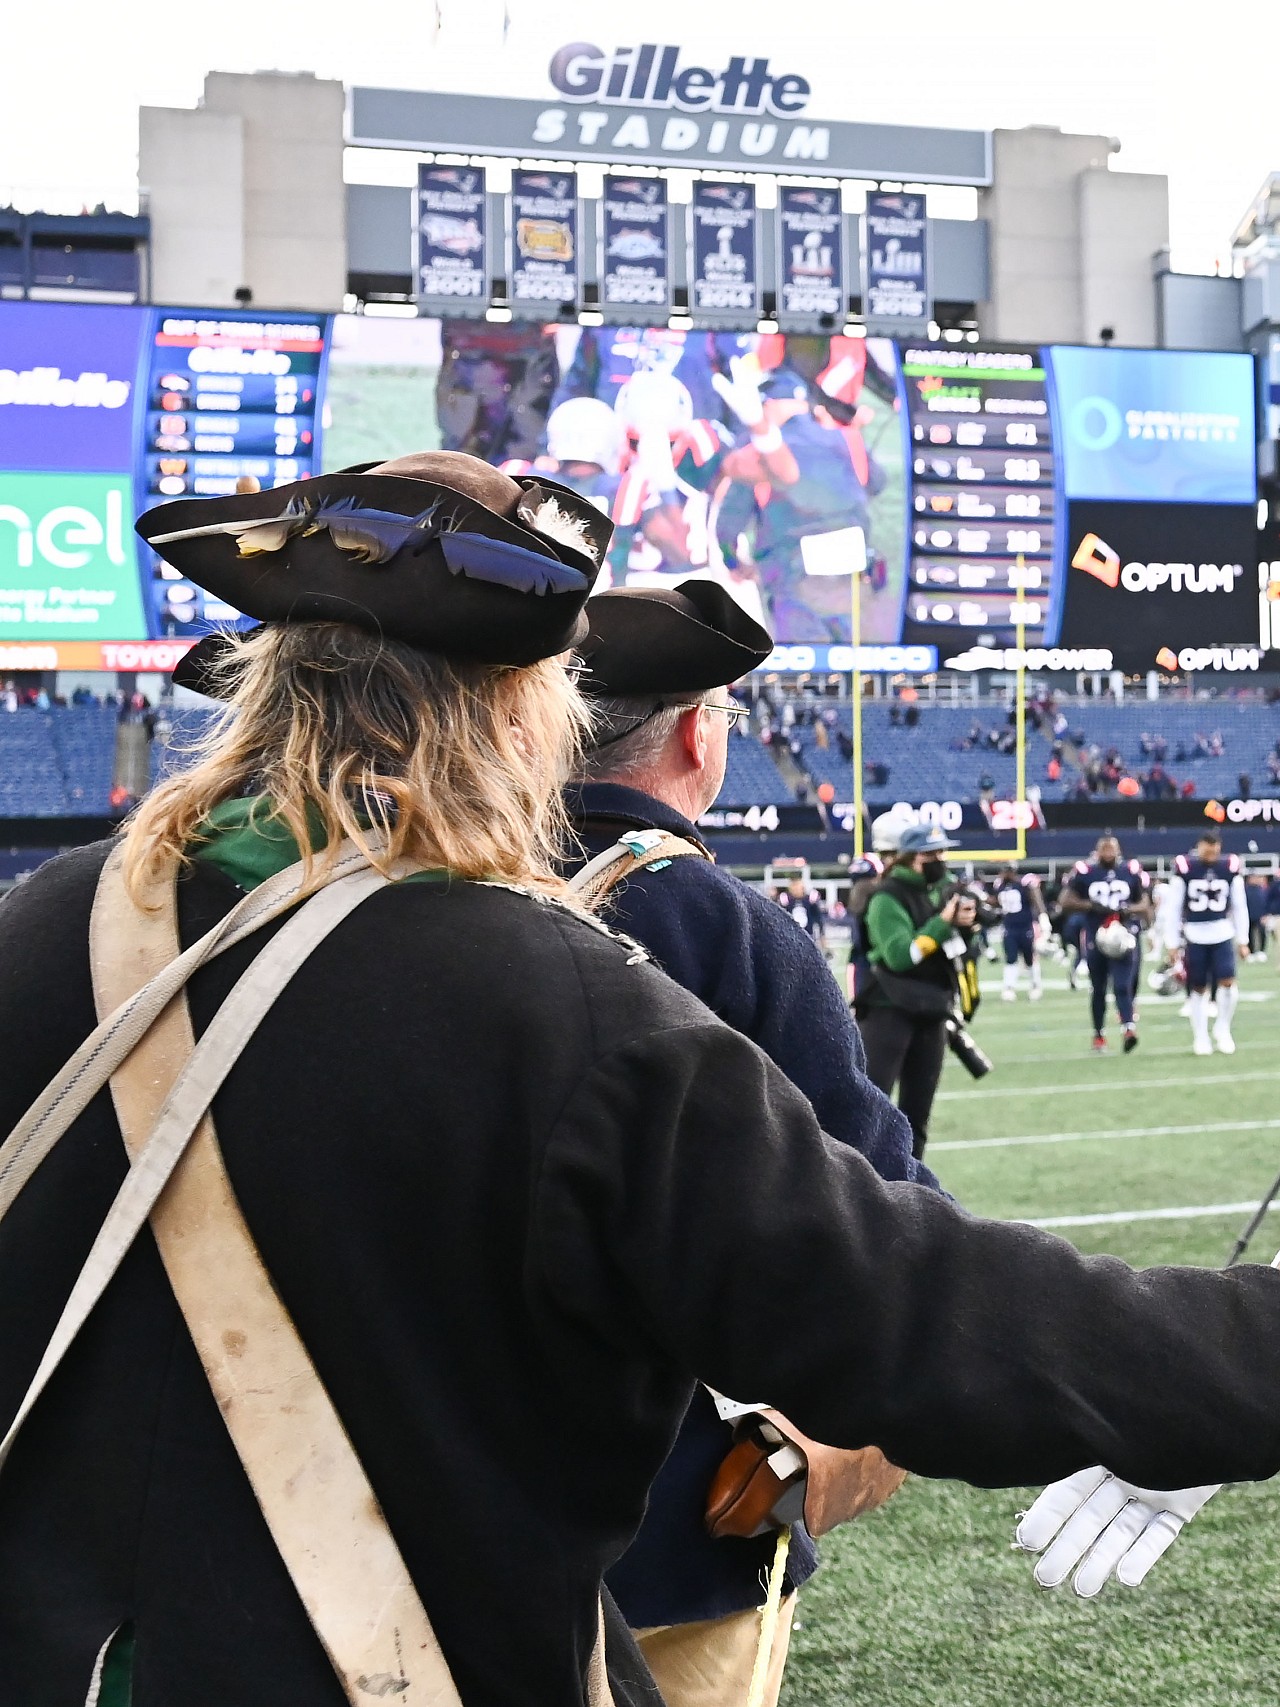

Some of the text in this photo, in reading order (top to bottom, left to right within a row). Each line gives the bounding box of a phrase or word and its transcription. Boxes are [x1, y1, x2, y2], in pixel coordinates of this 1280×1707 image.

[549, 40, 811, 114] Gillette
[534, 109, 831, 160] STADIUM
[1121, 562, 1234, 593] OPTUM
[102, 644, 189, 668] TOYOT
[1178, 648, 1260, 671] OPTUM
[1187, 879, 1230, 912] 53
